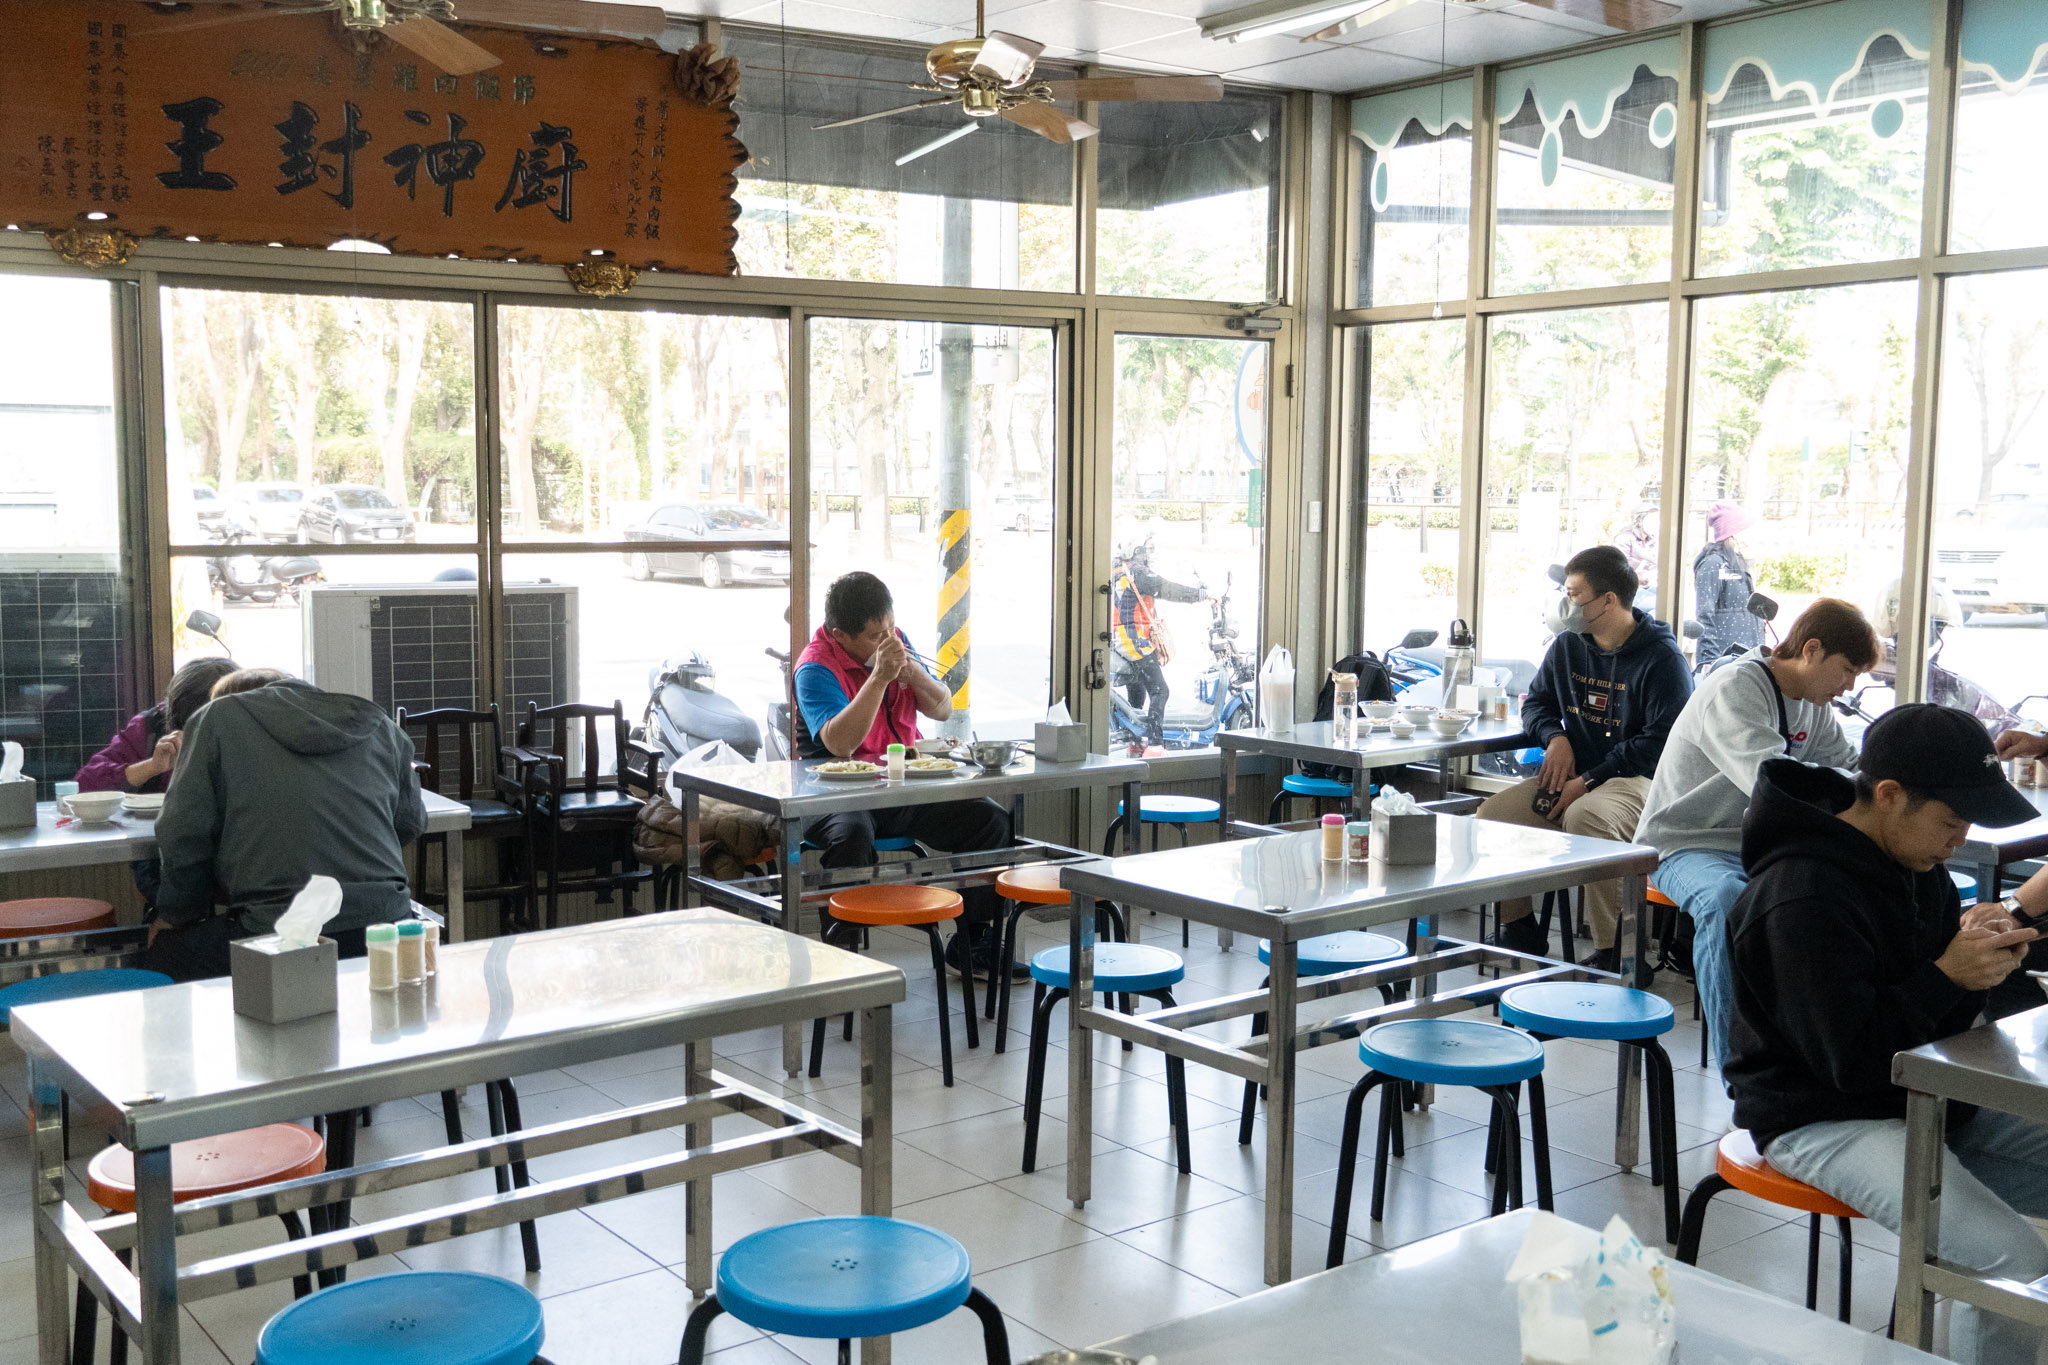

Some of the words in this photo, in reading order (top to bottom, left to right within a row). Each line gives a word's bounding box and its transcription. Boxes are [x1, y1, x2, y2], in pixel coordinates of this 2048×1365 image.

[1597, 680, 1626, 691] HILFGER
[1581, 710, 1602, 724] YORK
[1603, 718, 1621, 727] CTY
